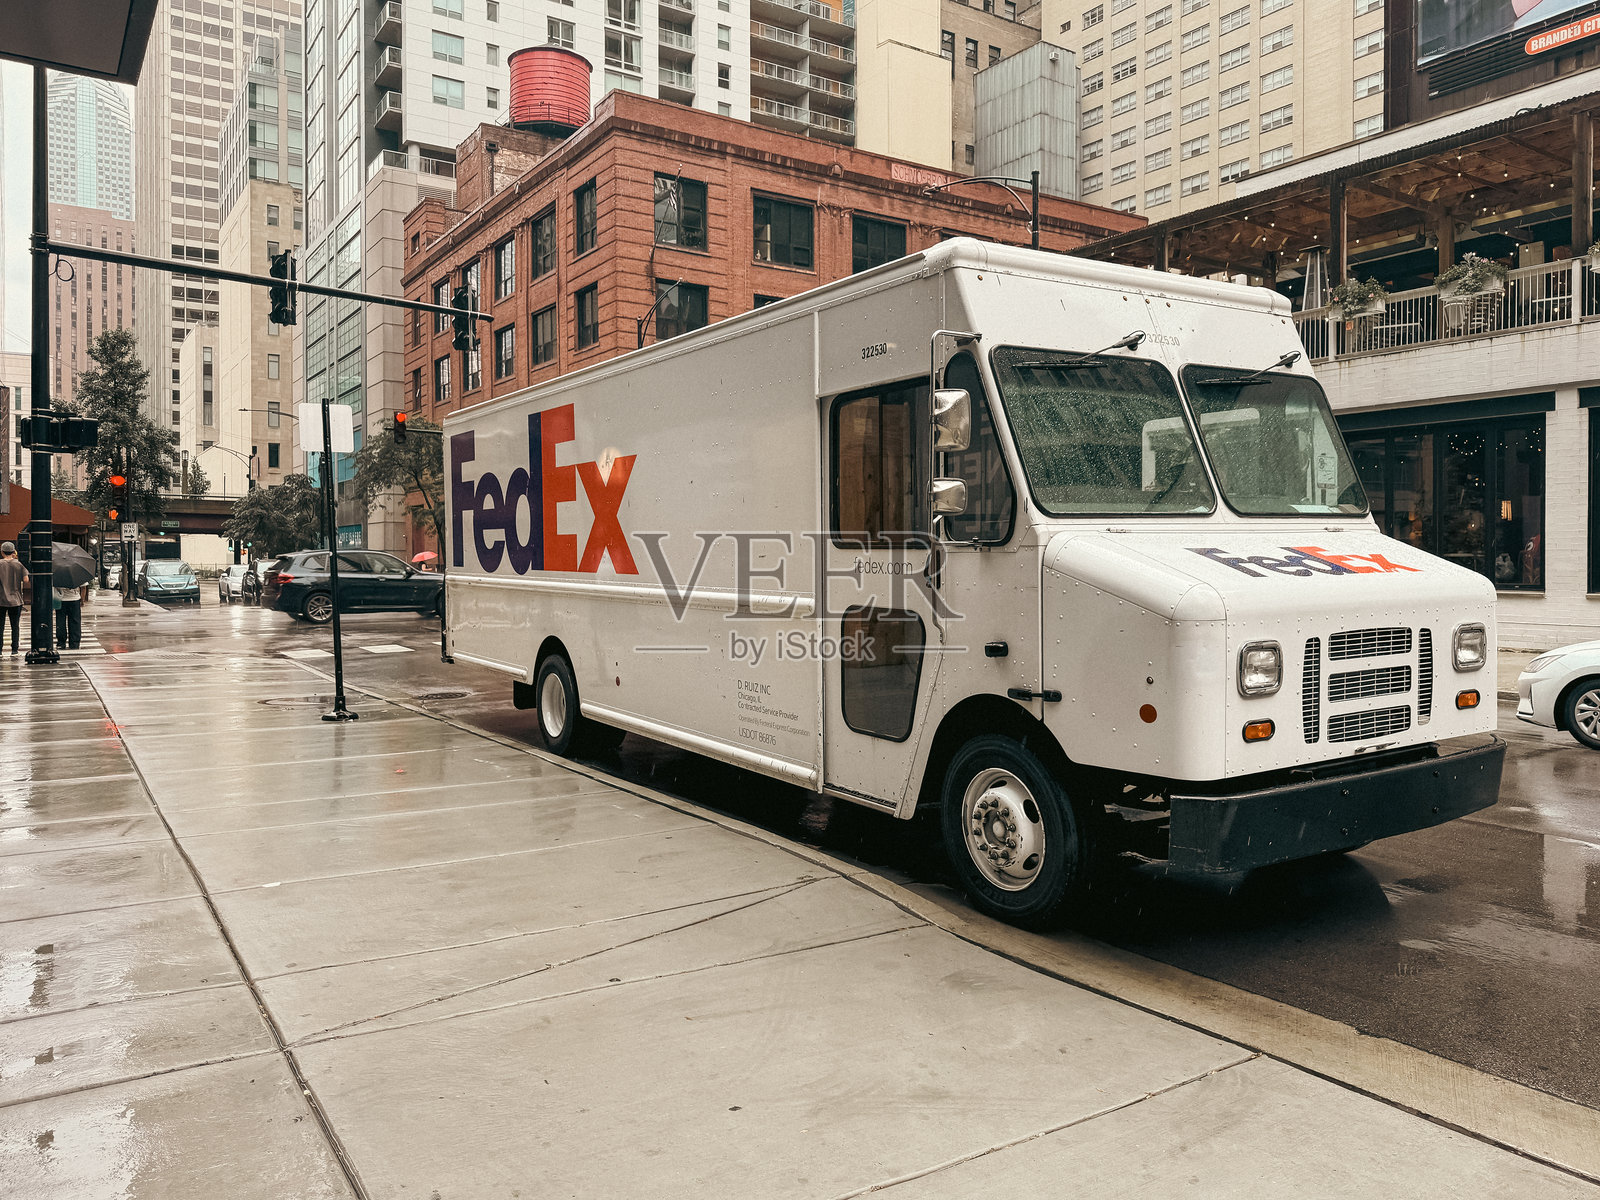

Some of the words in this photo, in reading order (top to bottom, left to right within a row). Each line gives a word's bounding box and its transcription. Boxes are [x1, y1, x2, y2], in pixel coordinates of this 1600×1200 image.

[1531, 24, 1581, 52] BRANDED
[1147, 333, 1180, 346] 322530
[861, 342, 888, 360] 322530
[451, 402, 640, 576] FedEx
[853, 556, 913, 576] fedex.com
[1183, 546, 1425, 578] FedEx
[737, 679, 744, 690] D.
[744, 681, 759, 693] RUIZ
[760, 684, 771, 696] INC
[738, 701, 761, 713] Contracted
[762, 706, 779, 717] Service
[779, 710, 799, 721] Provider
[738, 727, 758, 740] USDOT
